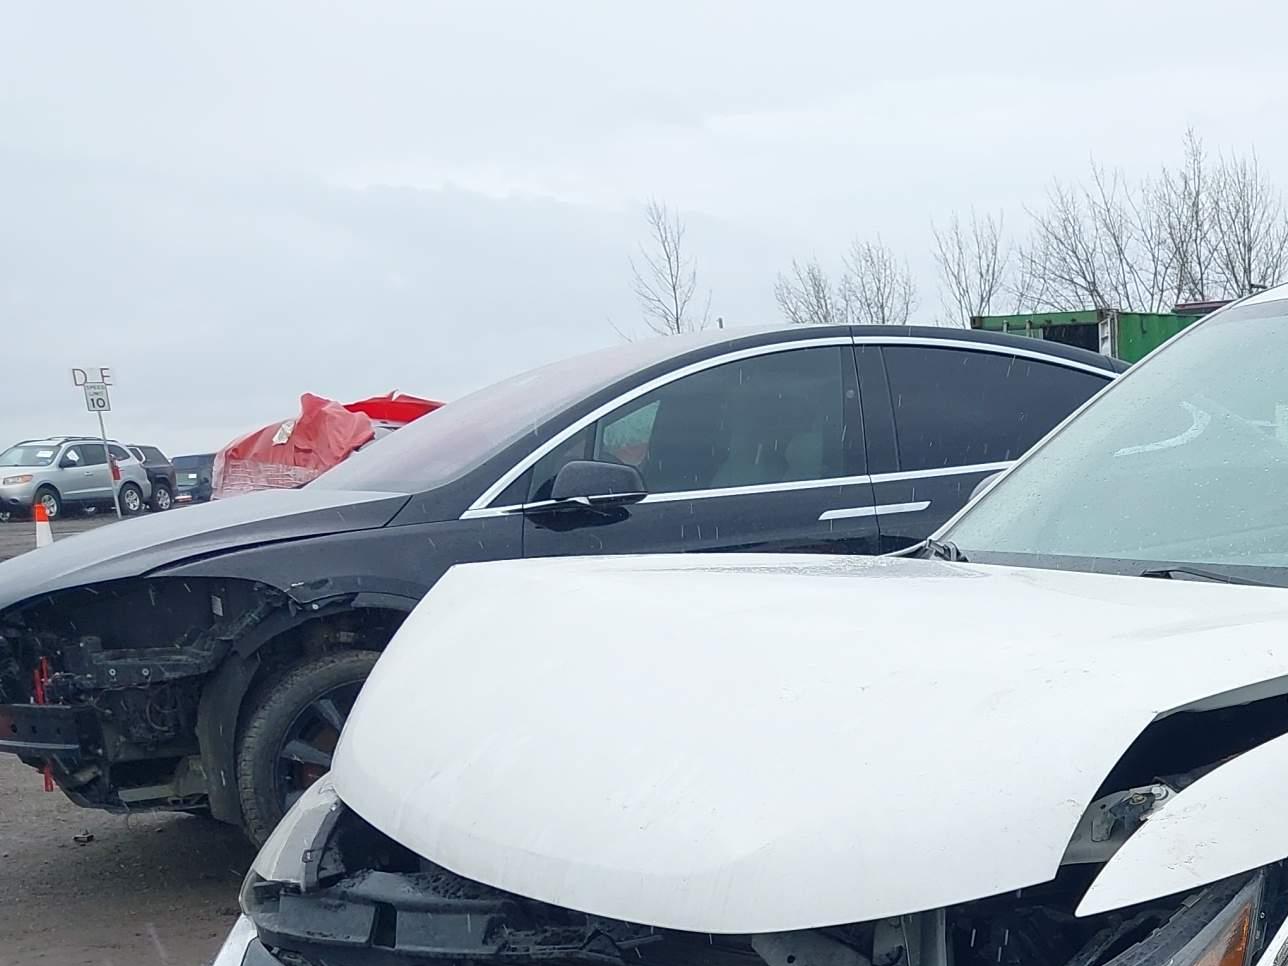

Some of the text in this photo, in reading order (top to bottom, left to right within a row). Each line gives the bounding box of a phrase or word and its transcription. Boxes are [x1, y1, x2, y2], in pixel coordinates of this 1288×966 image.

[72, 368, 112, 386] D E
[90, 397, 106, 408] 10
